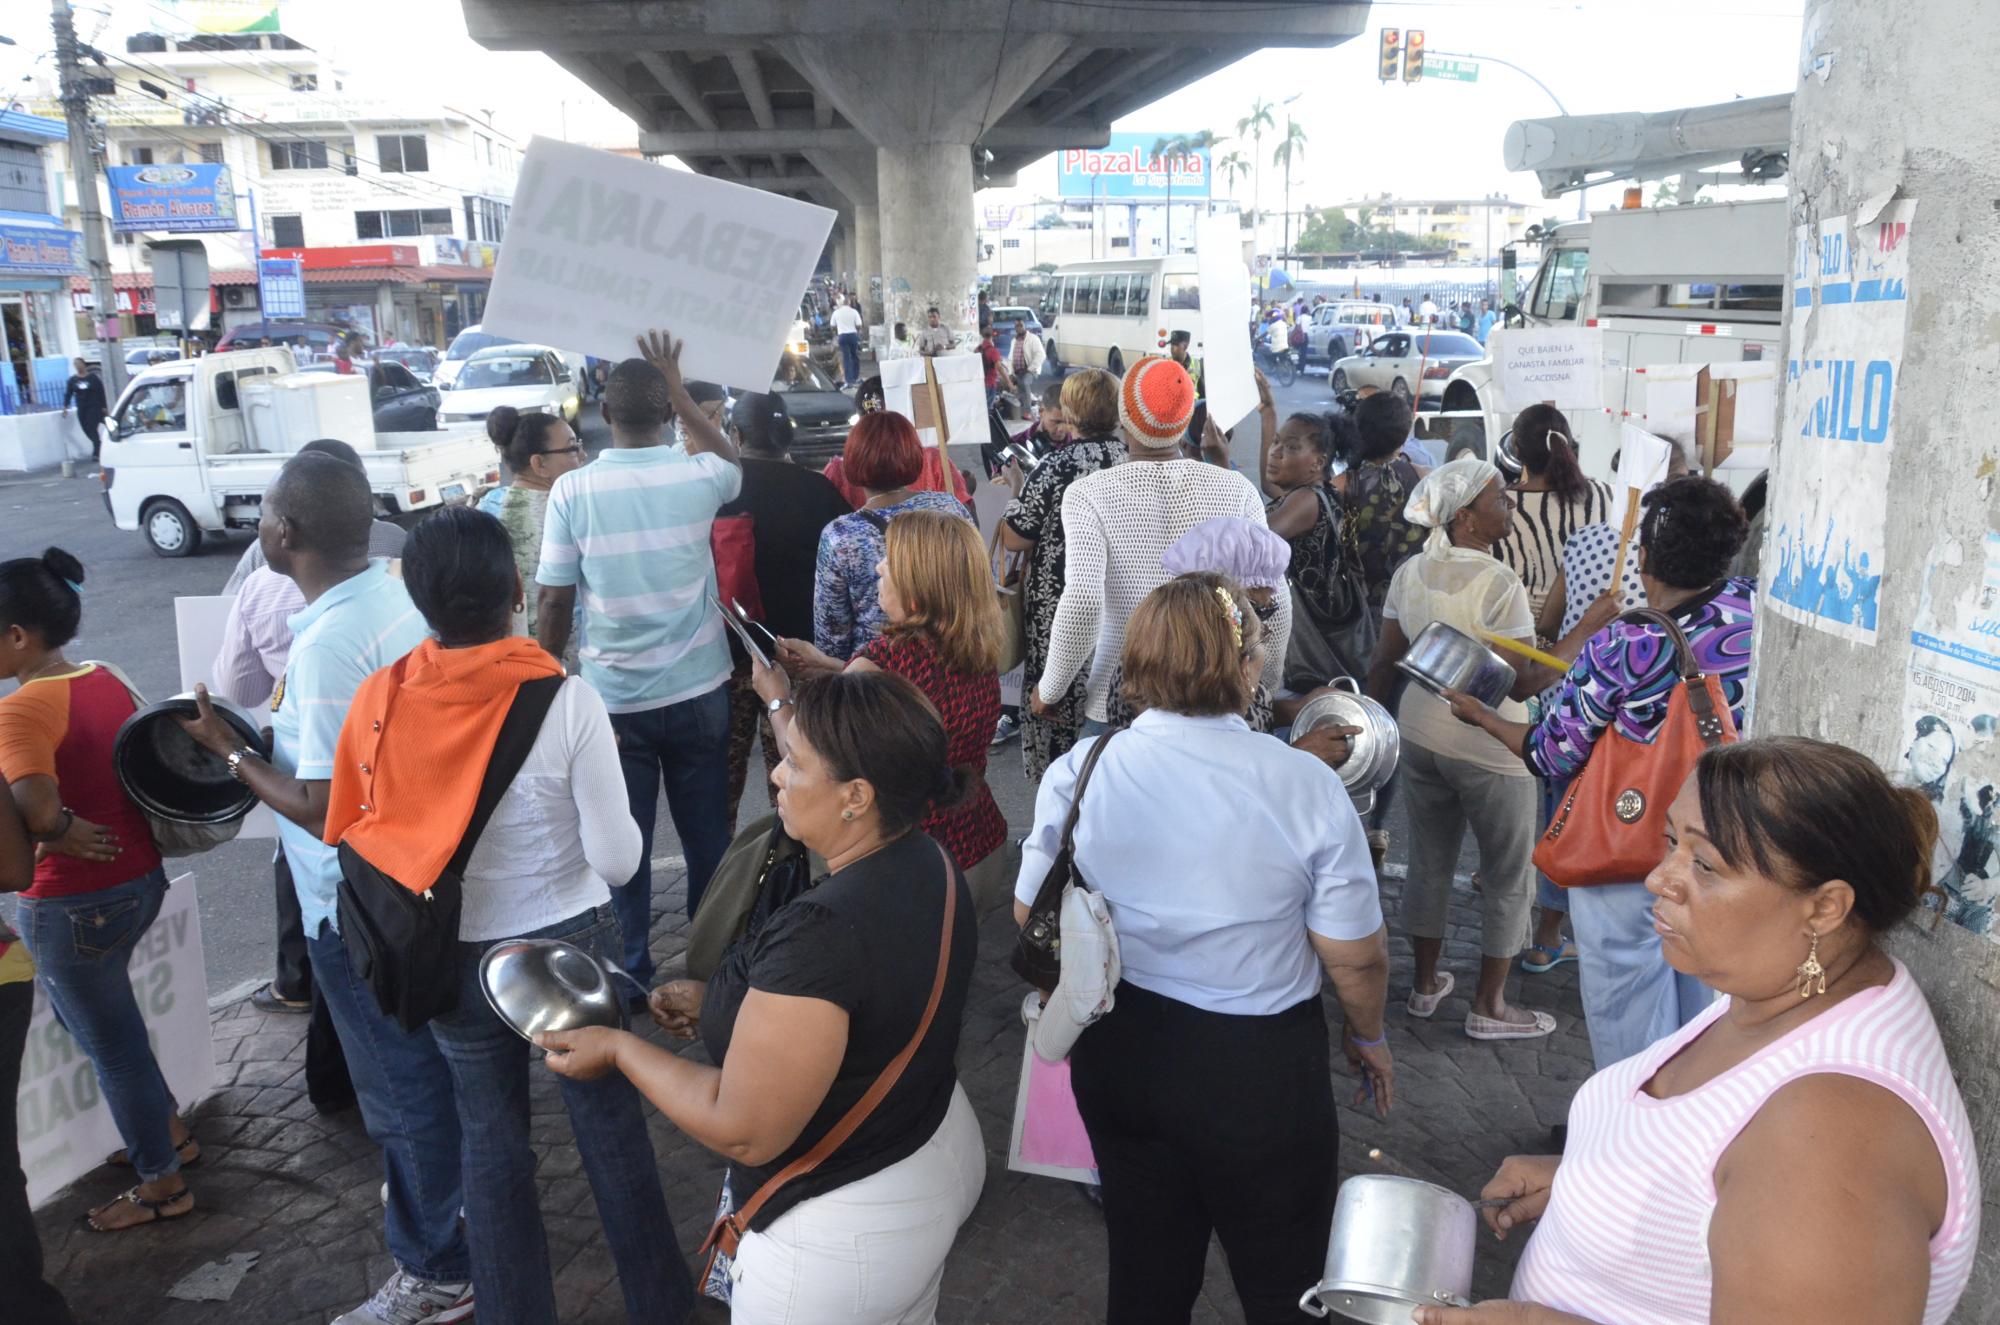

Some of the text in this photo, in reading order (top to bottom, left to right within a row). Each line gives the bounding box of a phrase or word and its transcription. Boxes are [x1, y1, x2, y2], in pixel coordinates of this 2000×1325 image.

[1564, 344, 1575, 352] LA
[1508, 358, 1585, 370] CANASTA FAMILIAR
